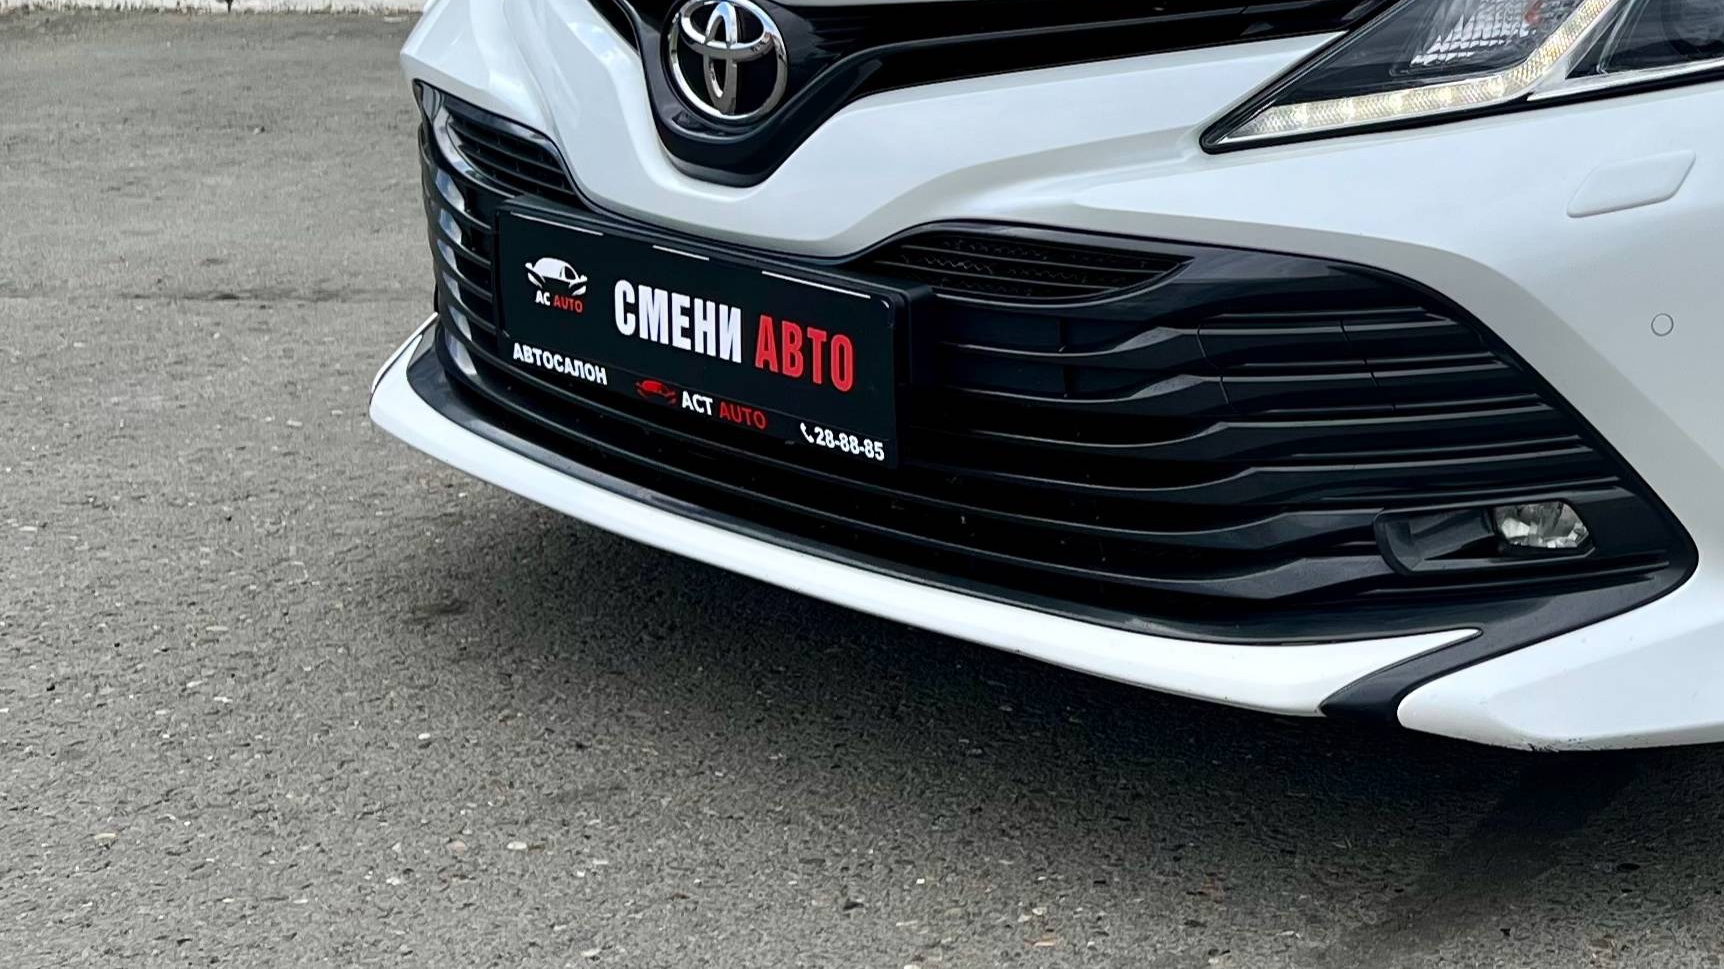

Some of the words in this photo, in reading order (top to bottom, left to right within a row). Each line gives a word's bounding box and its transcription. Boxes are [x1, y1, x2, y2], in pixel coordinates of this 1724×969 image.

[535, 289, 551, 306] AC
[553, 295, 583, 313] AUTO
[614, 279, 742, 364] СМЕНИ
[754, 314, 854, 392] АВТО
[513, 342, 607, 385] АВТОСАЛОН
[720, 401, 768, 429] AUTO
[814, 426, 885, 461] 28-88-85
